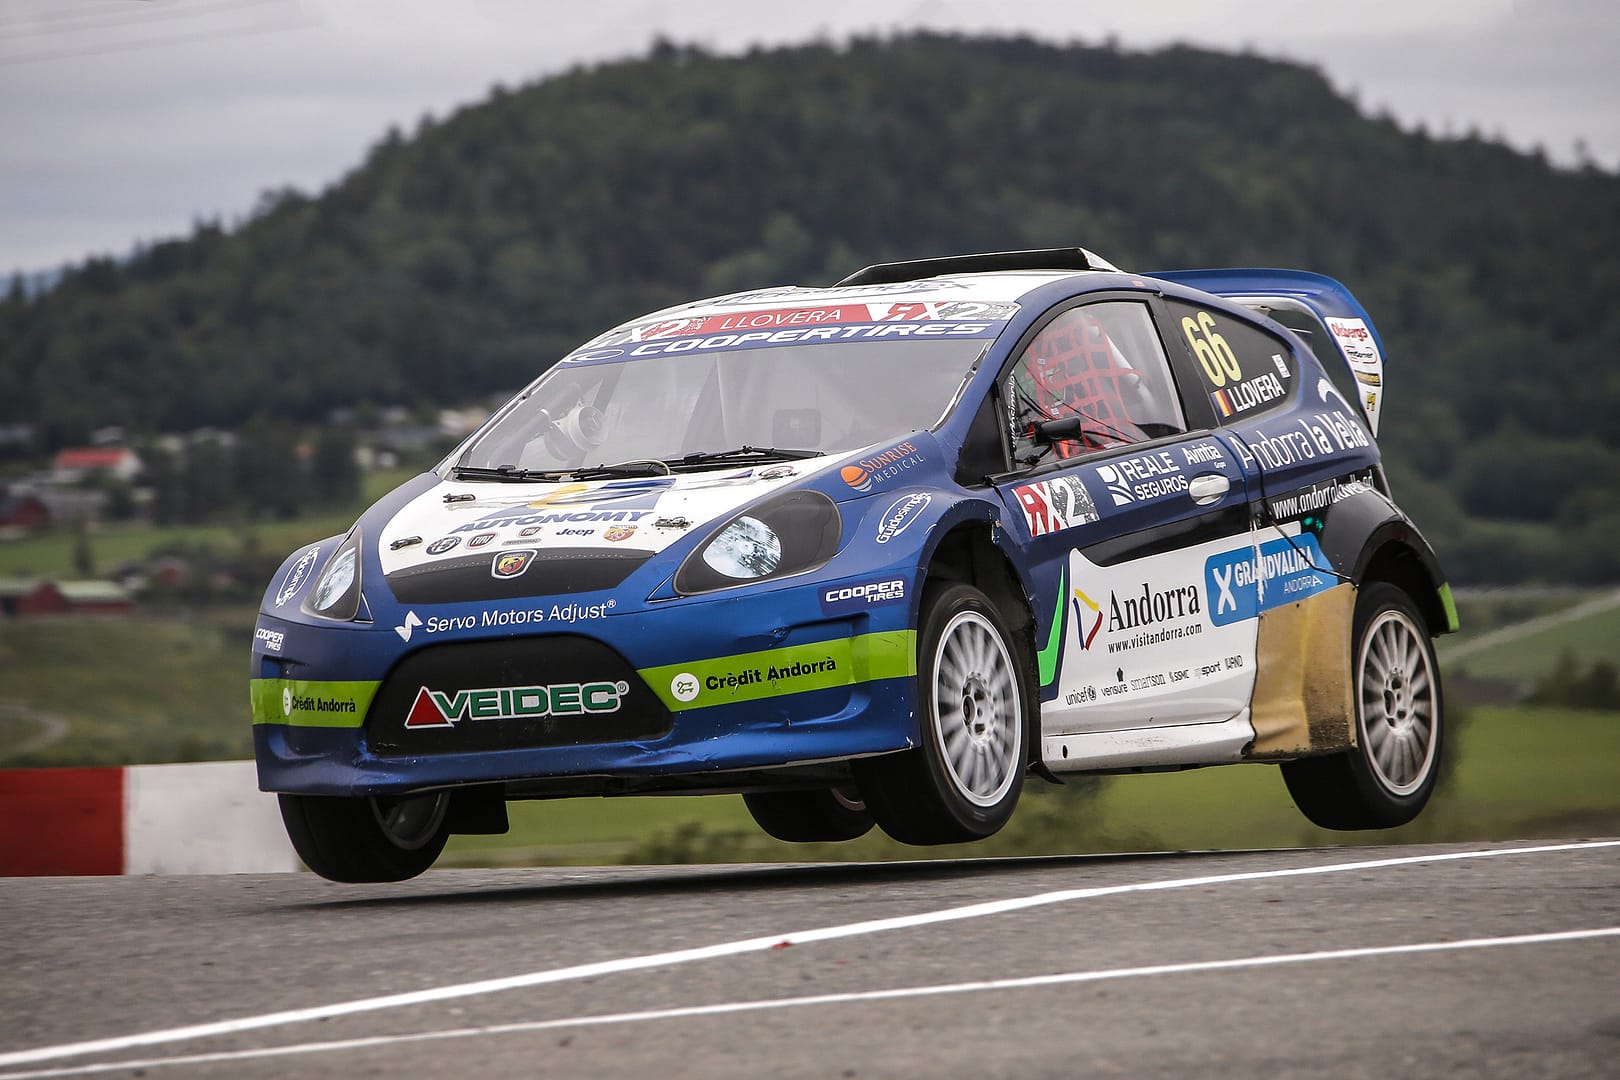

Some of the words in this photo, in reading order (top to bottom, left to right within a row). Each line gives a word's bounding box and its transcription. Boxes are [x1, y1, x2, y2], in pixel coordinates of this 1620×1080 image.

[719, 308, 842, 331] LLOVERA
[1181, 311, 1242, 387] 66
[1227, 372, 1286, 413] LLOVERA
[1298, 419, 1335, 455] la
[1314, 410, 1370, 451] Vella
[859, 441, 917, 473] SUNRISE
[1181, 442, 1223, 465] Avintia
[1228, 430, 1316, 471] Andorra
[873, 453, 925, 484] MEDICAL
[1118, 452, 1181, 481] REALE
[1133, 474, 1190, 501] SEGUROS
[448, 511, 655, 535] AUTONOMY
[555, 528, 595, 536] Jeep
[470, 534, 494, 547] FIAT
[825, 580, 904, 603] COOPER
[864, 590, 905, 603] TIRES
[1283, 575, 1323, 595] ANDORRA
[1108, 582, 1201, 633] Andorra
[426, 615, 476, 633] Servo
[481, 608, 544, 627] Motors
[256, 628, 284, 644] COOPER
[265, 640, 282, 652] TIRES
[1108, 623, 1203, 654] www.visitandorra.com
[705, 669, 763, 690] Crèdit
[767, 656, 836, 682] Andorrà
[292, 695, 316, 711] Crèdit
[317, 697, 356, 713] Andorrà
[1065, 686, 1088, 706] unicef
